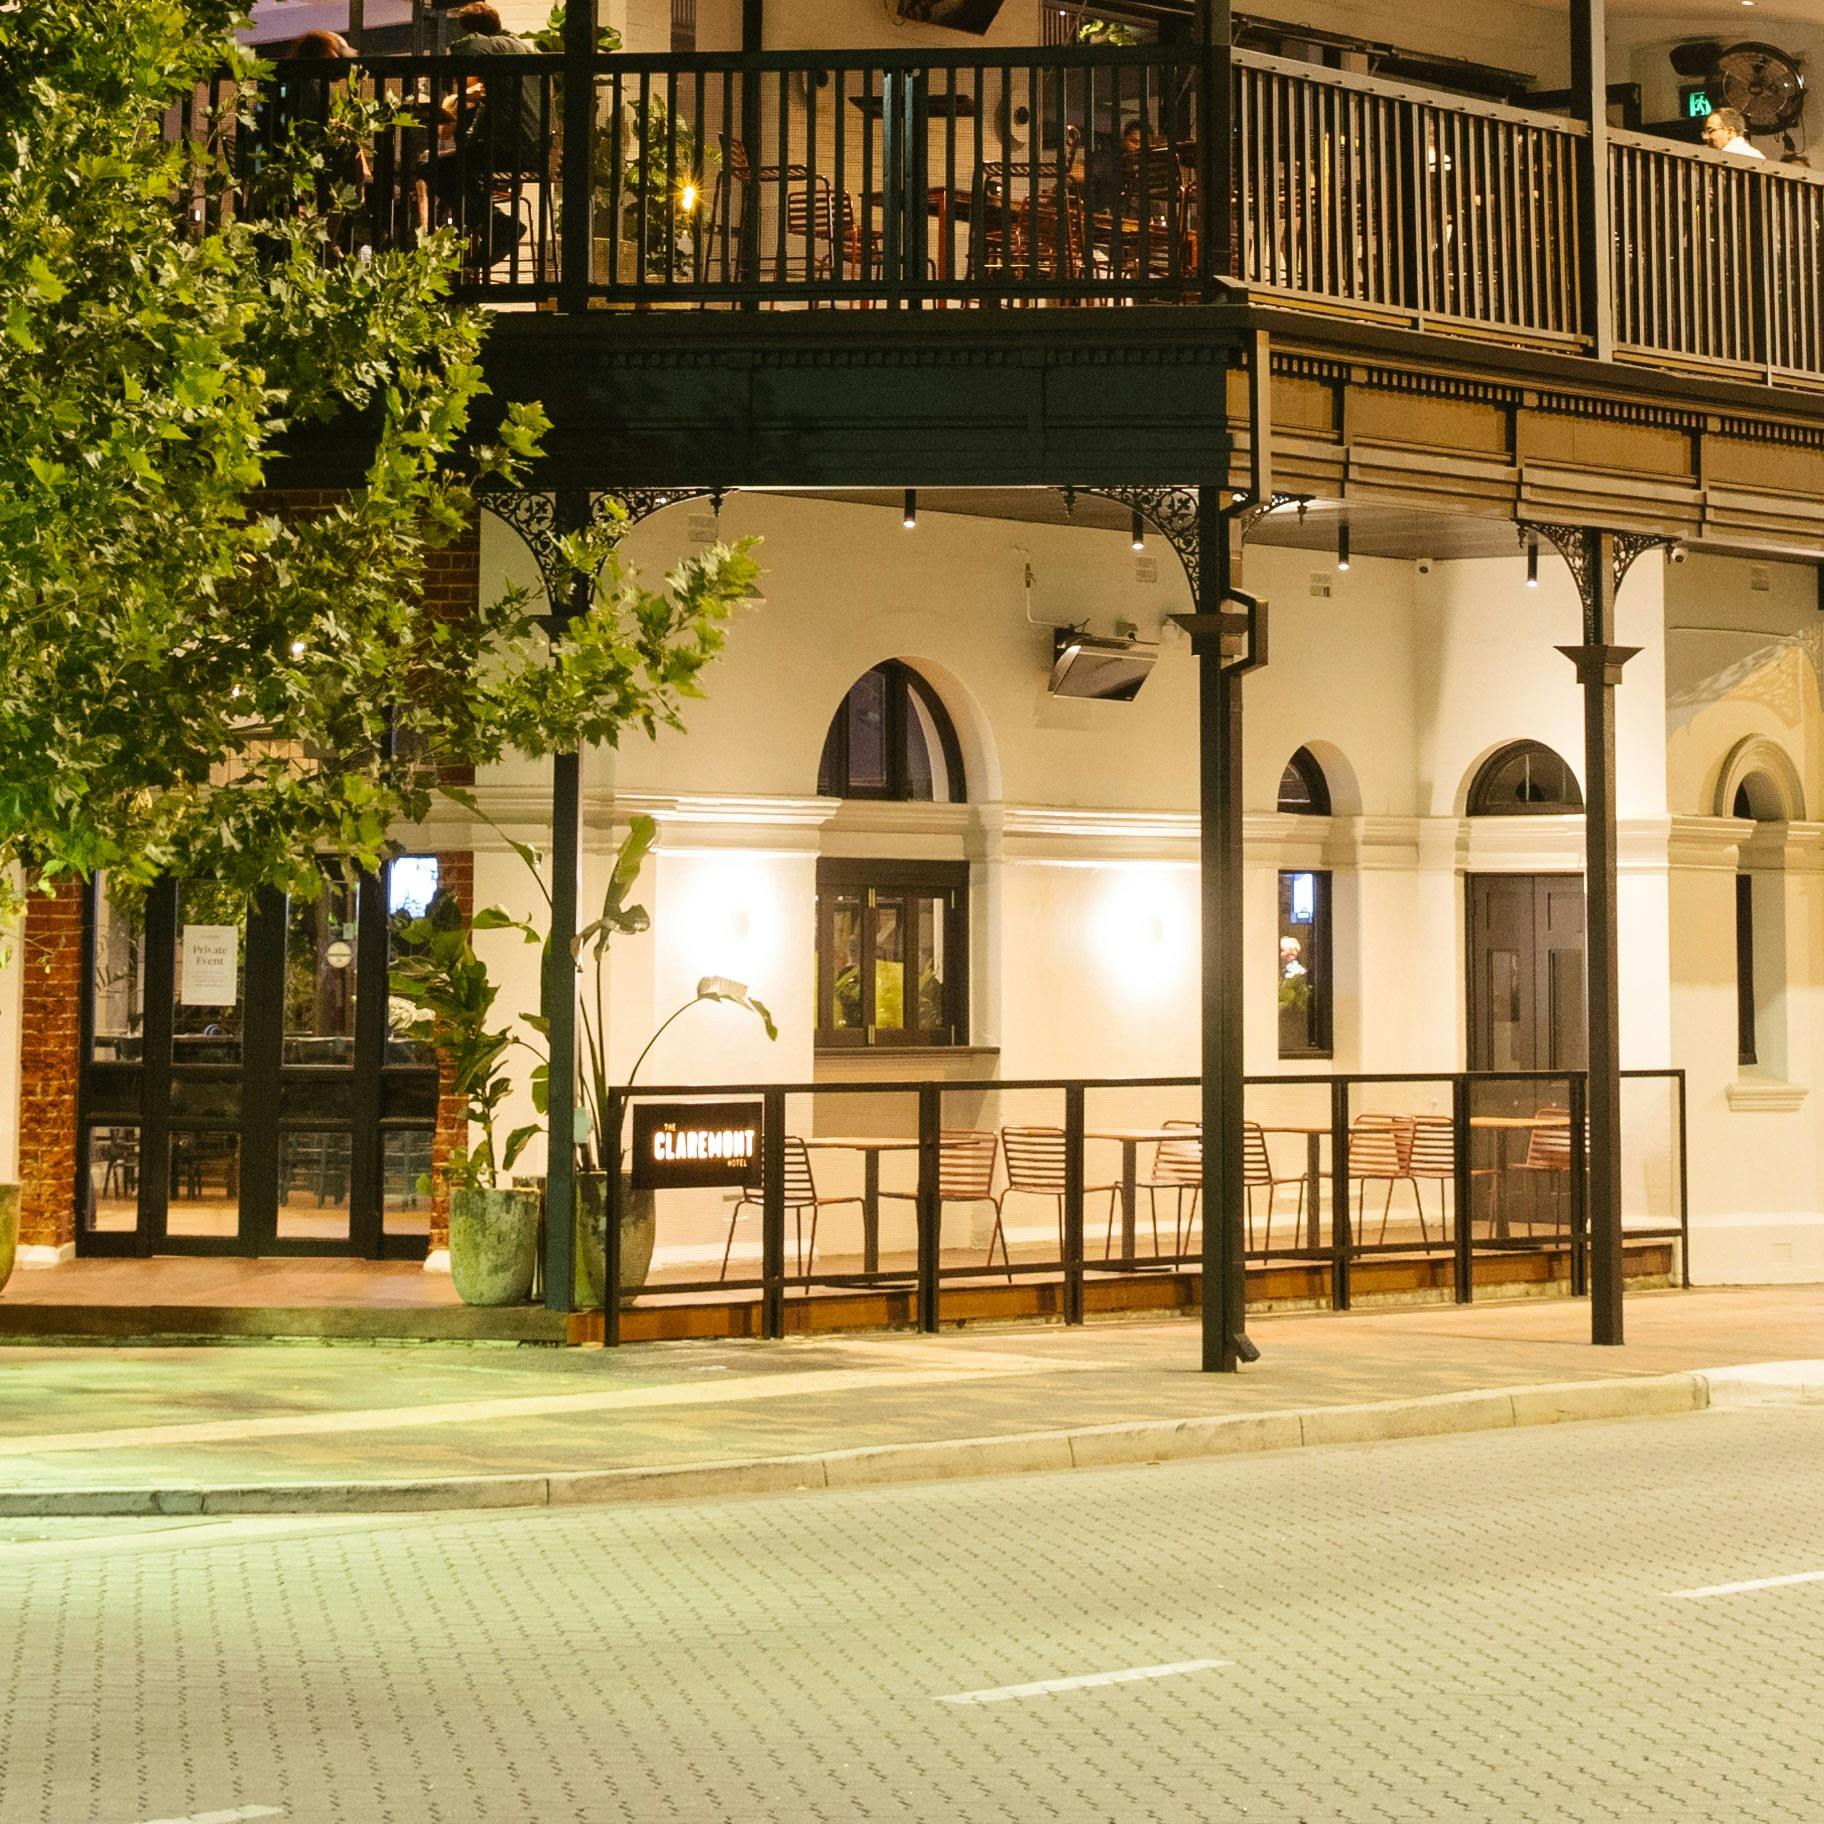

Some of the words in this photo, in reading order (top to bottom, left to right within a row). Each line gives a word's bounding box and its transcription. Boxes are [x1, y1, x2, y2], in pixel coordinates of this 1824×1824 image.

[192, 944, 228, 955] Private
[196, 957, 224, 966] Event
[664, 1123, 676, 1131] THE
[653, 1130, 754, 1160] CLAREMONT
[727, 1159, 747, 1167] HOTEL
